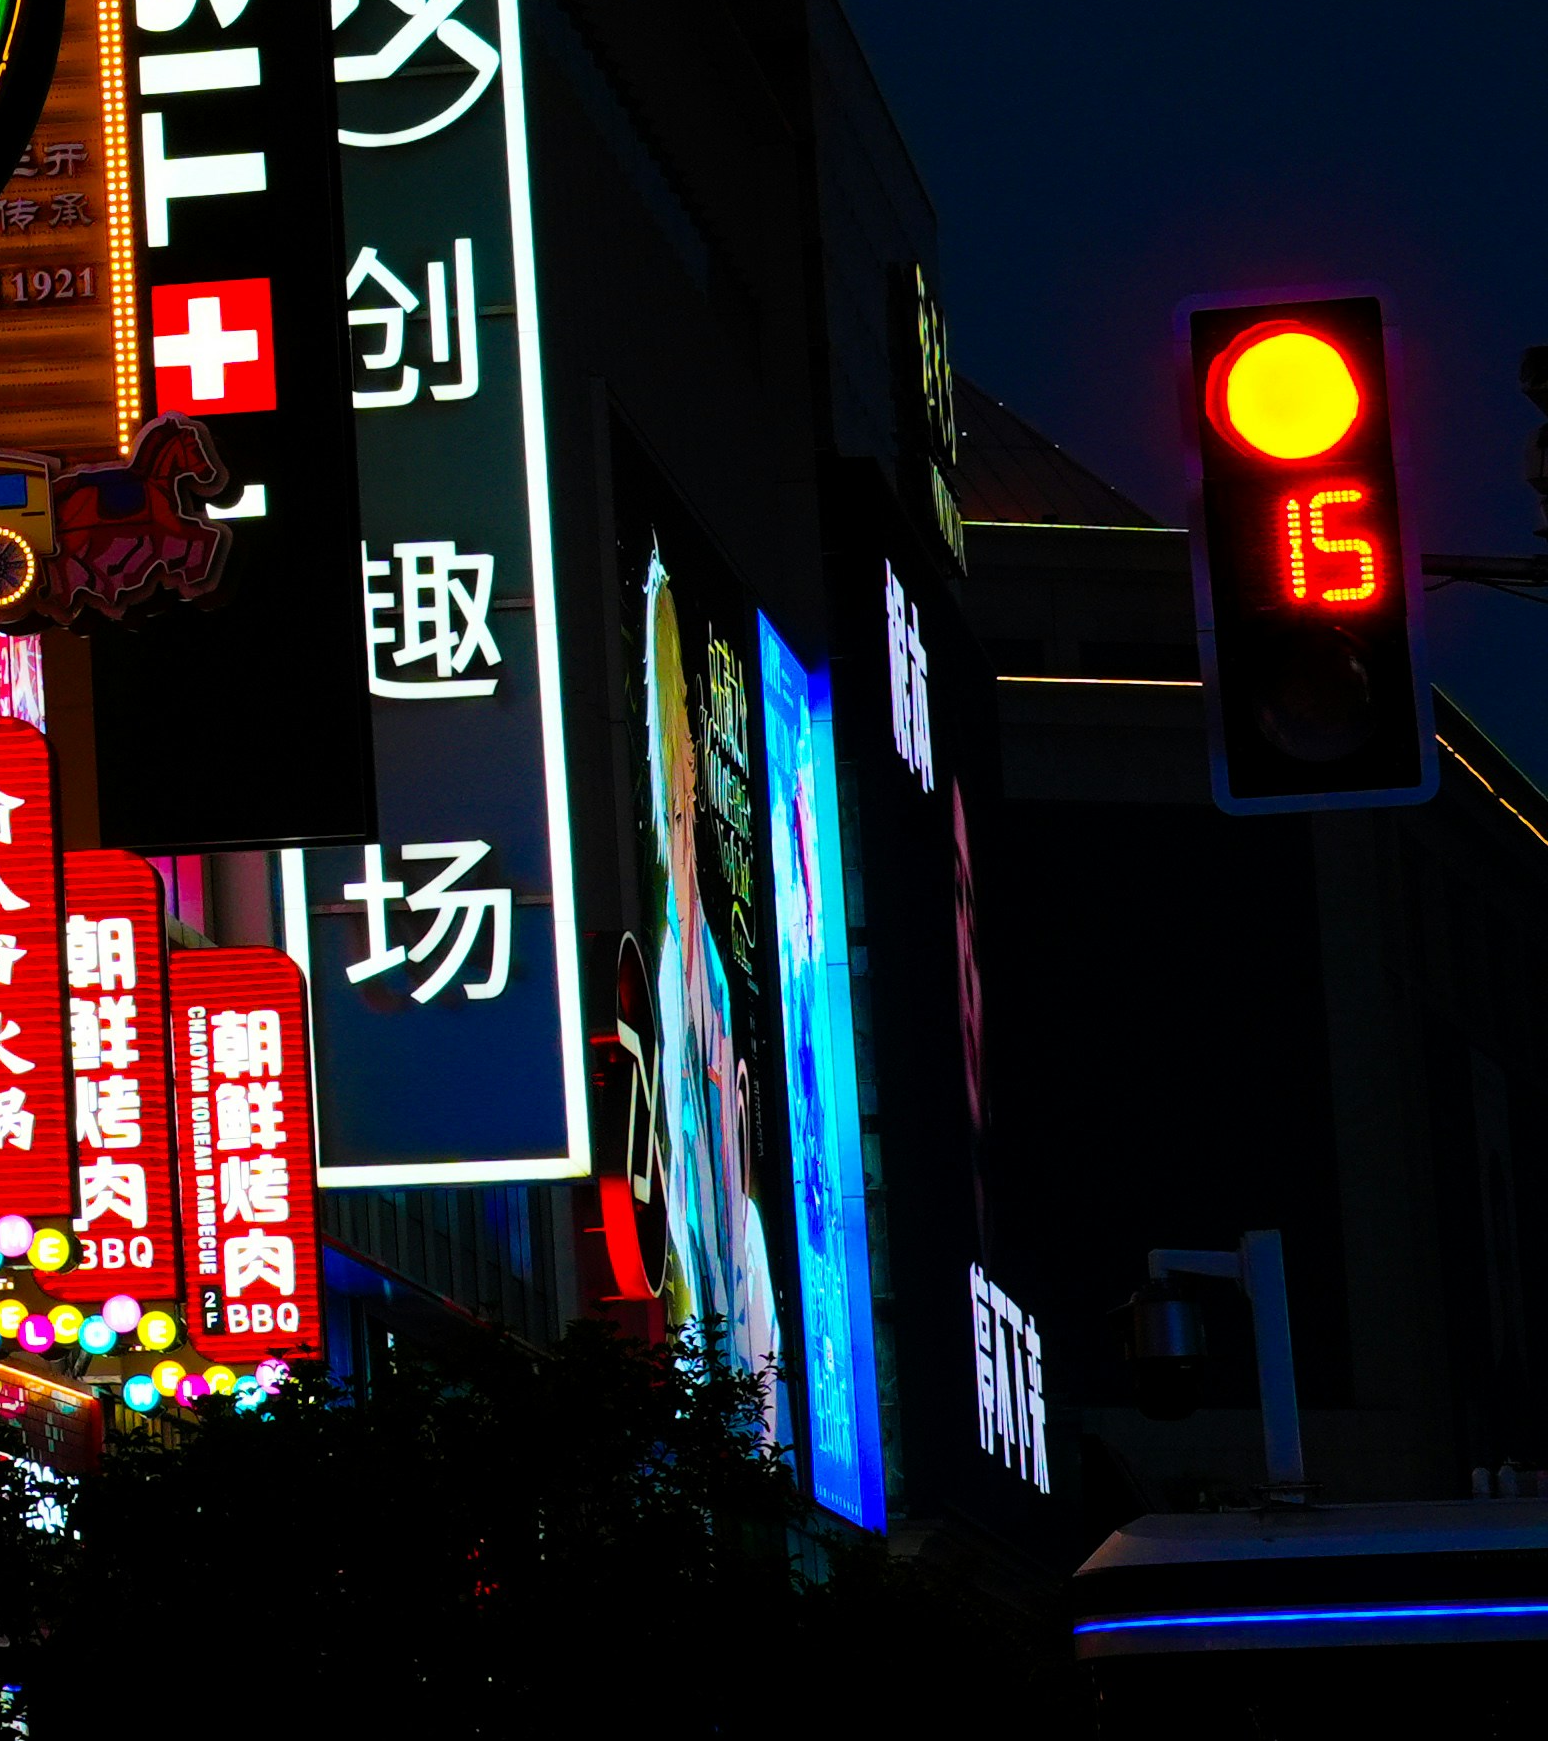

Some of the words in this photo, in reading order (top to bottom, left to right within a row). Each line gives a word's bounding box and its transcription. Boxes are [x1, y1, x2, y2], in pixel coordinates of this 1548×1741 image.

[11, 266, 96, 303] 1921
[1285, 488, 1377, 604] 15
[65, 914, 150, 1232] 朝鲜烤肉
[186, 1005, 210, 1093] CHAOYAN
[191, 1095, 213, 1171] KOREAN
[210, 1009, 296, 1298] 朝鲜烤肉
[195, 1173, 218, 1276] BARBECUE
[204, 1290, 219, 1329] 2F
[226, 1302, 300, 1335] BBQ
